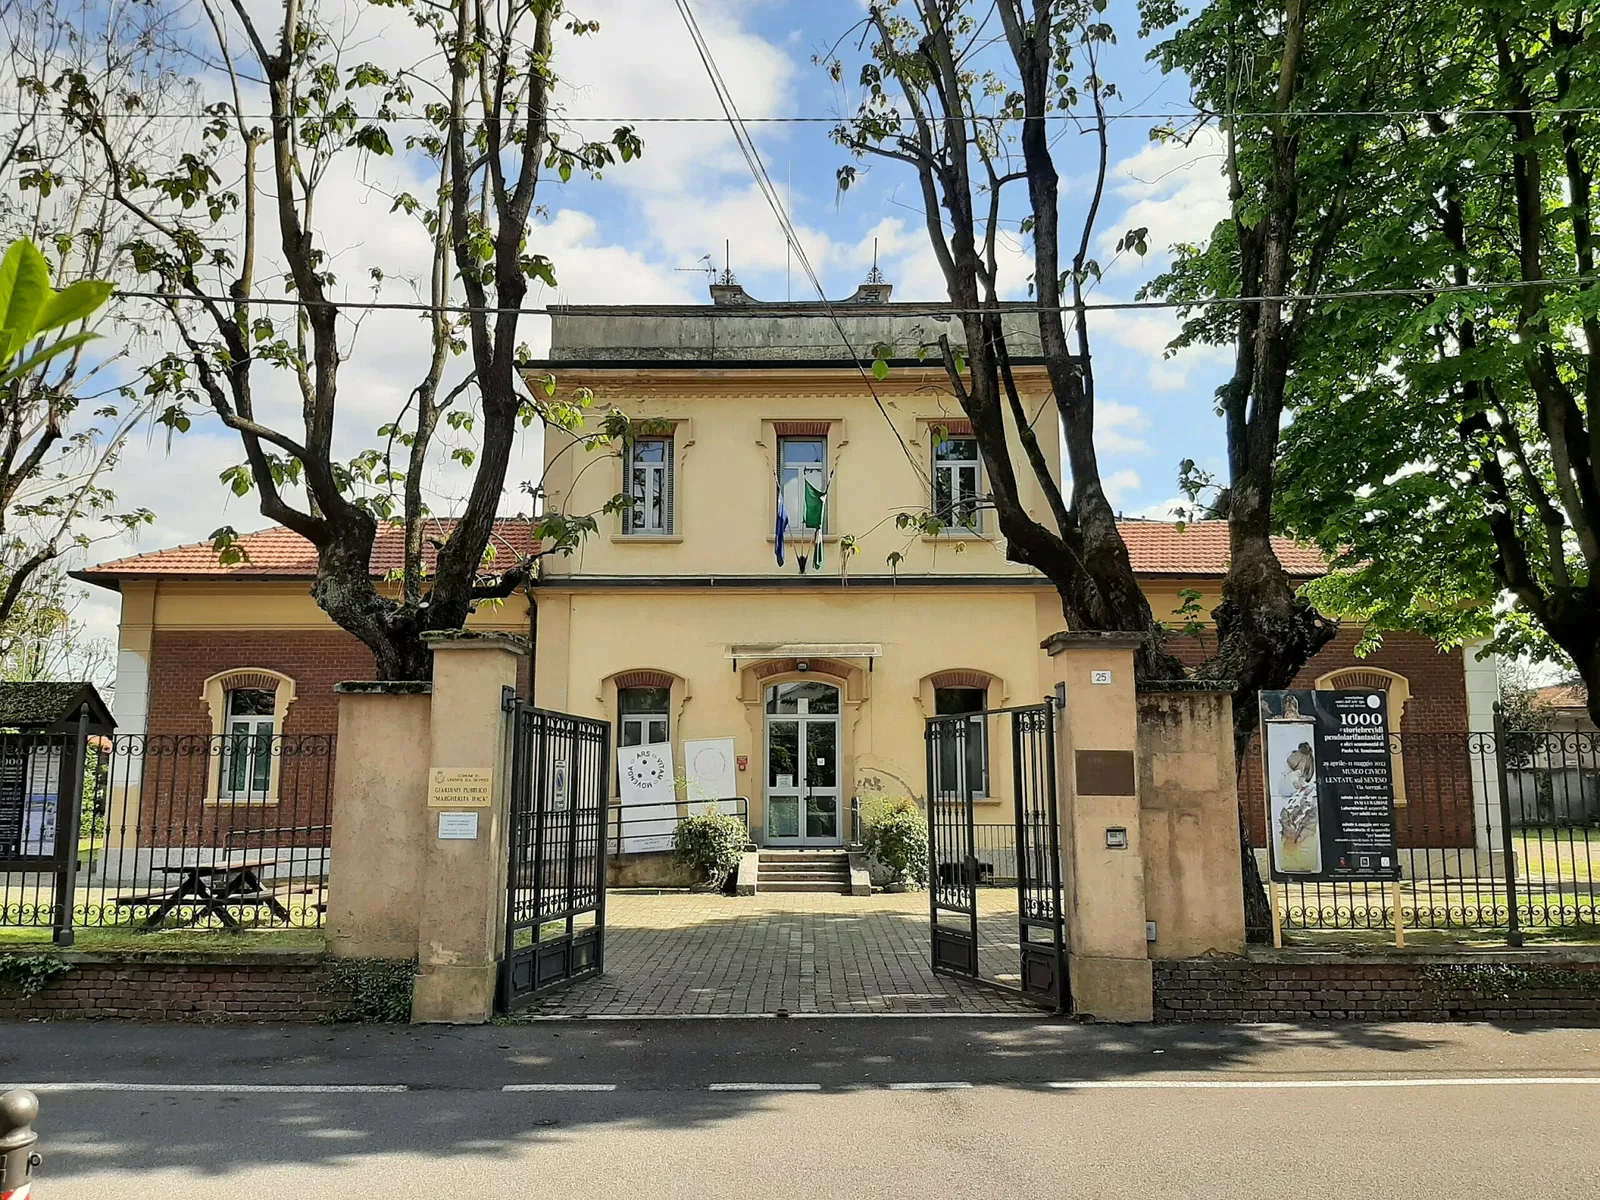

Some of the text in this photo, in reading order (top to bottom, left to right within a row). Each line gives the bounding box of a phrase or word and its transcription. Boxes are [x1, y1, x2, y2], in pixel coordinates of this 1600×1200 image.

[1096, 673, 1106, 682] 25
[1340, 713, 1382, 725] 1000
[636, 750, 650, 759] ARS
[656, 758, 664, 780] VITAM
[628, 766, 652, 789] MOVENDA
